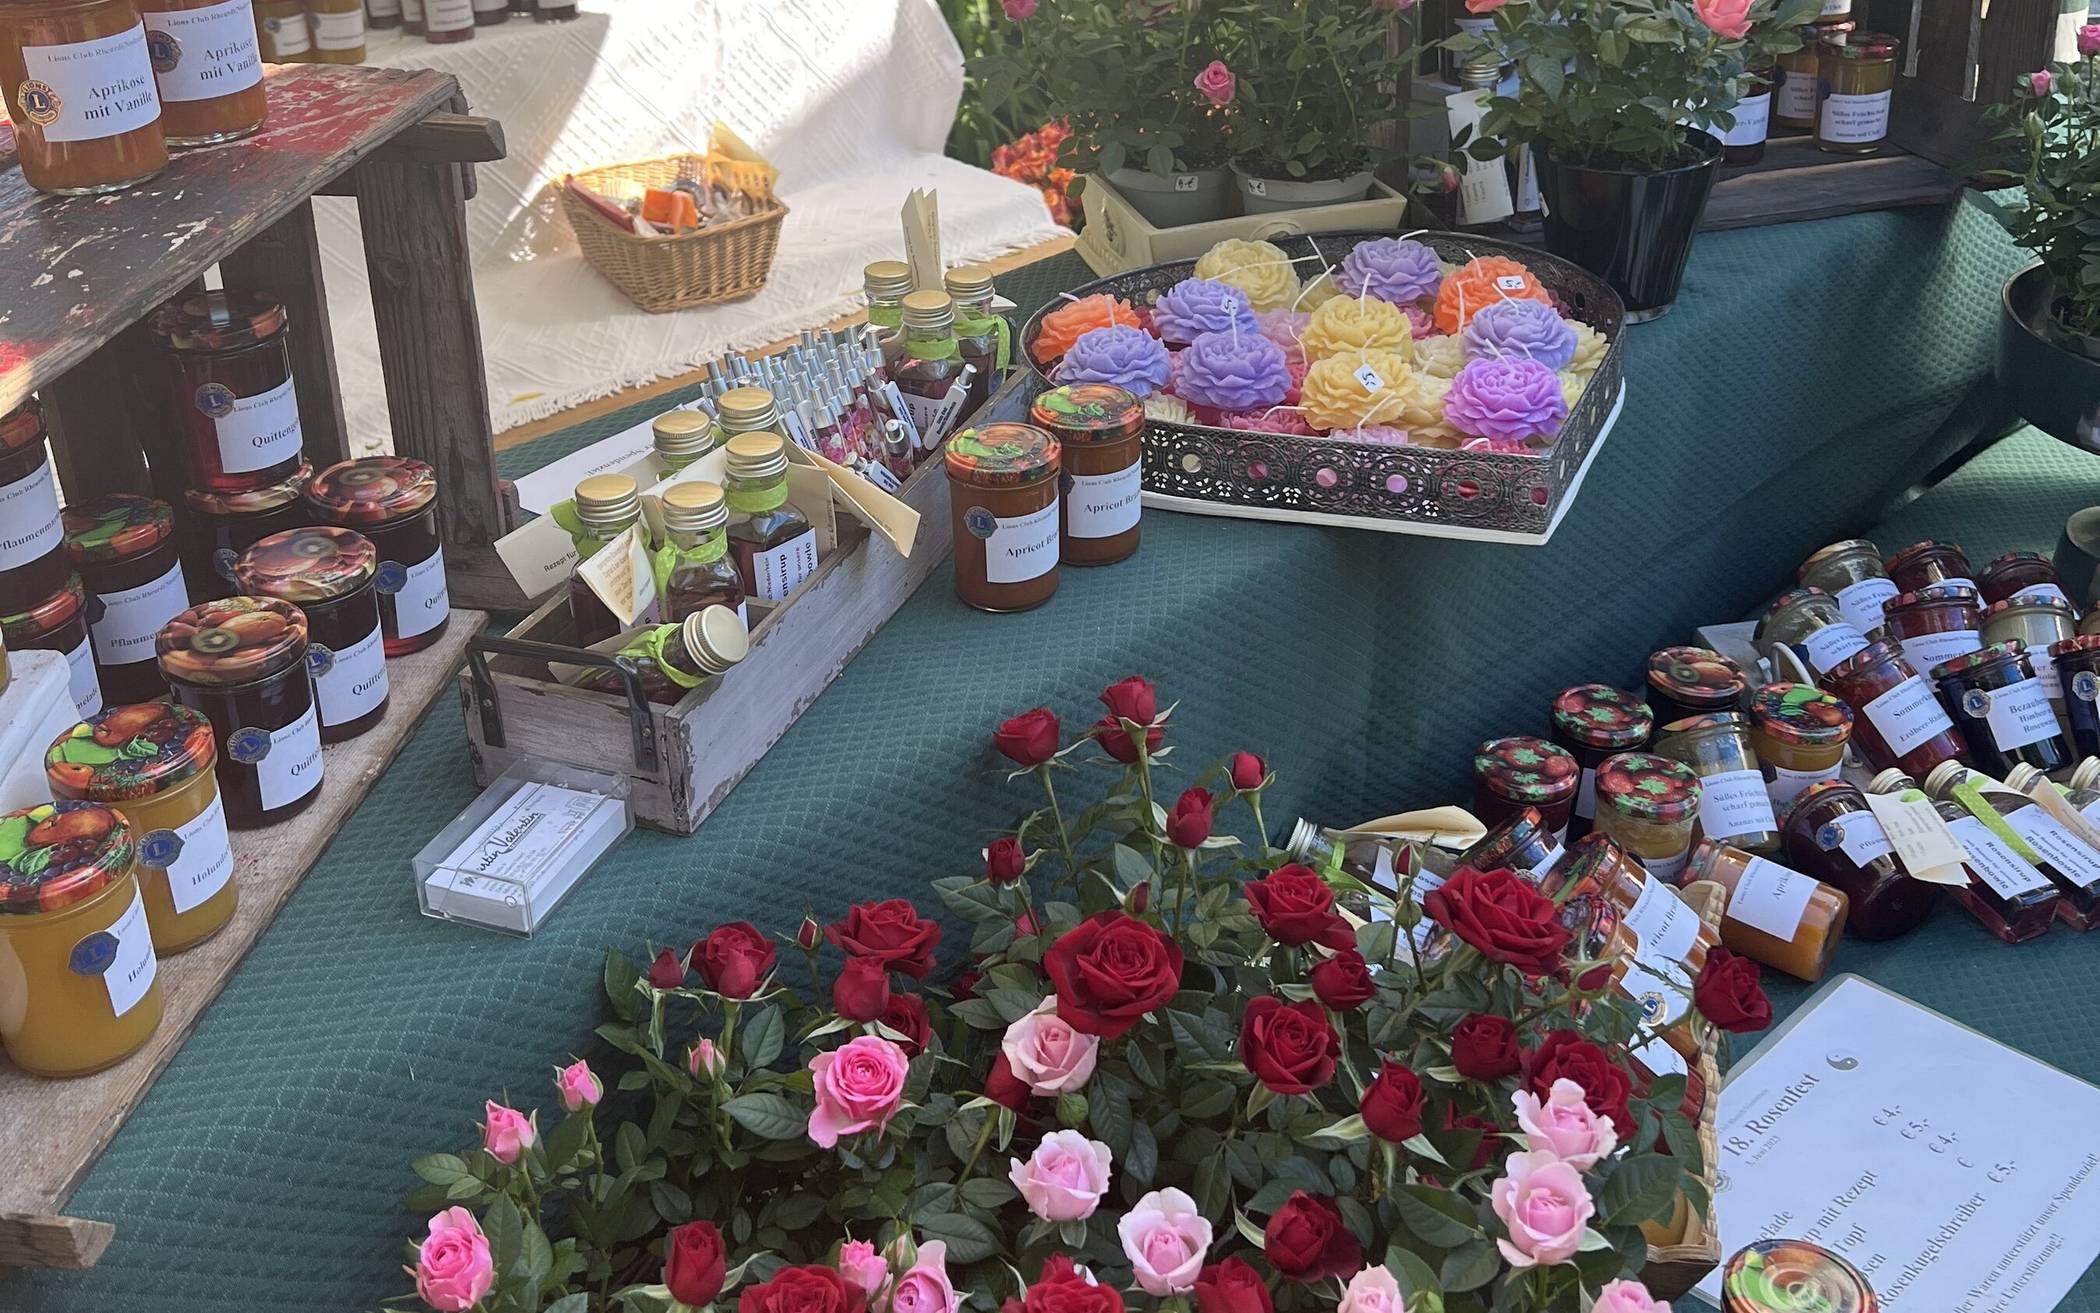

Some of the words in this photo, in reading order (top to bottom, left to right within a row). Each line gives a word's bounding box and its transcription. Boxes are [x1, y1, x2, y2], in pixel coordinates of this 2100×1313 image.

[203, 38, 254, 62] Aprikose
[88, 74, 145, 100] Aprikose
[200, 66, 224, 81] mit
[83, 103, 110, 120] mit
[115, 91, 152, 113] Vanille
[1084, 501, 1123, 515] Apricot
[543, 556, 566, 572] Rezept
[1005, 540, 1044, 559] Apricot
[779, 553, 789, 598] ensirup
[1985, 840, 2032, 883] Rosensirup
[2025, 835, 2081, 879] Rosenbowle
[2049, 829, 2100, 870] Rosensirup
[1722, 1136, 1755, 1157] 18.
[1744, 1072, 1821, 1136] Rosenfest
[1816, 1205, 1841, 1232] mit
[1833, 1168, 1880, 1212] Rezept
[1833, 1221, 1868, 1254] Topf
[1878, 1191, 1986, 1308] Rosenkugelschreiber
[1967, 1270, 2001, 1299] Waren
[1996, 1224, 2040, 1273] unterstützt
[2035, 1201, 2060, 1226] unser
